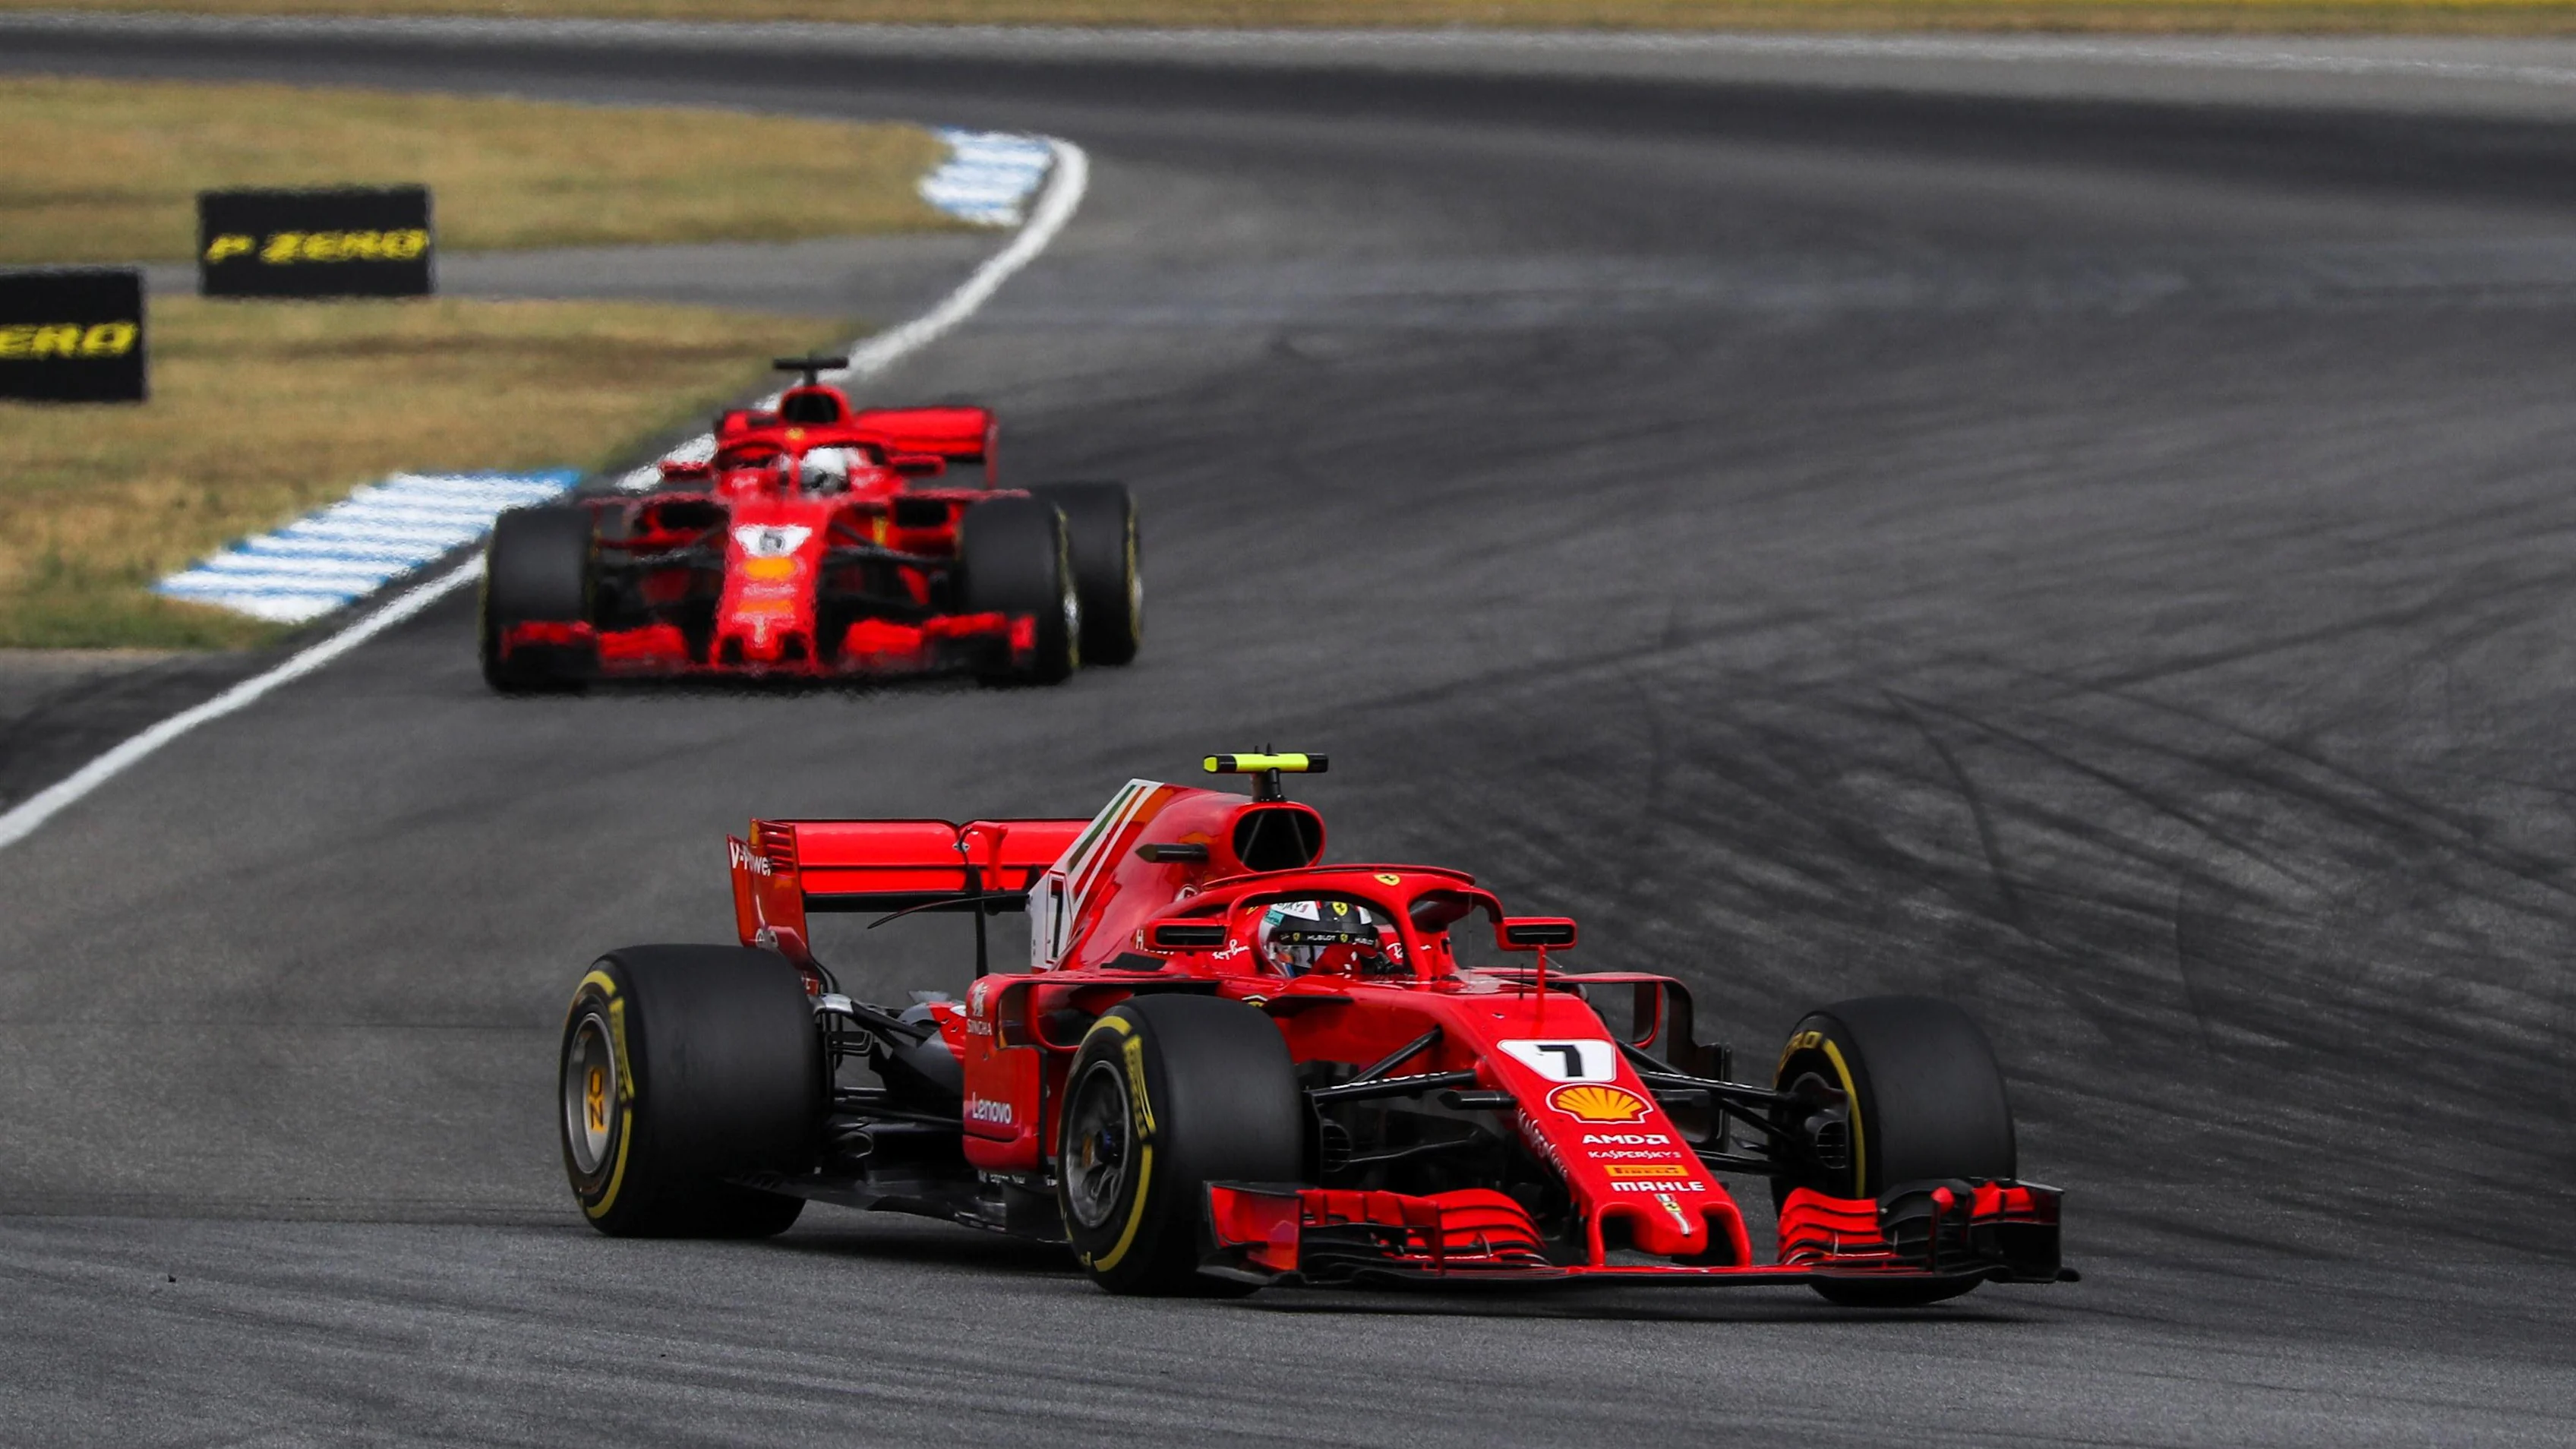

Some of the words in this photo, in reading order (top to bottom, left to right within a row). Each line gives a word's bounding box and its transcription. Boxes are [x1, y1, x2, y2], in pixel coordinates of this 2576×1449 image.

[204, 233, 254, 261] P
[260, 230, 428, 263] ZERO
[1050, 878, 1065, 958] 7
[1536, 1044, 1584, 1077] 7
[972, 1091, 1012, 1124] Lenovo
[1610, 1181, 1706, 1192] MAHLE
